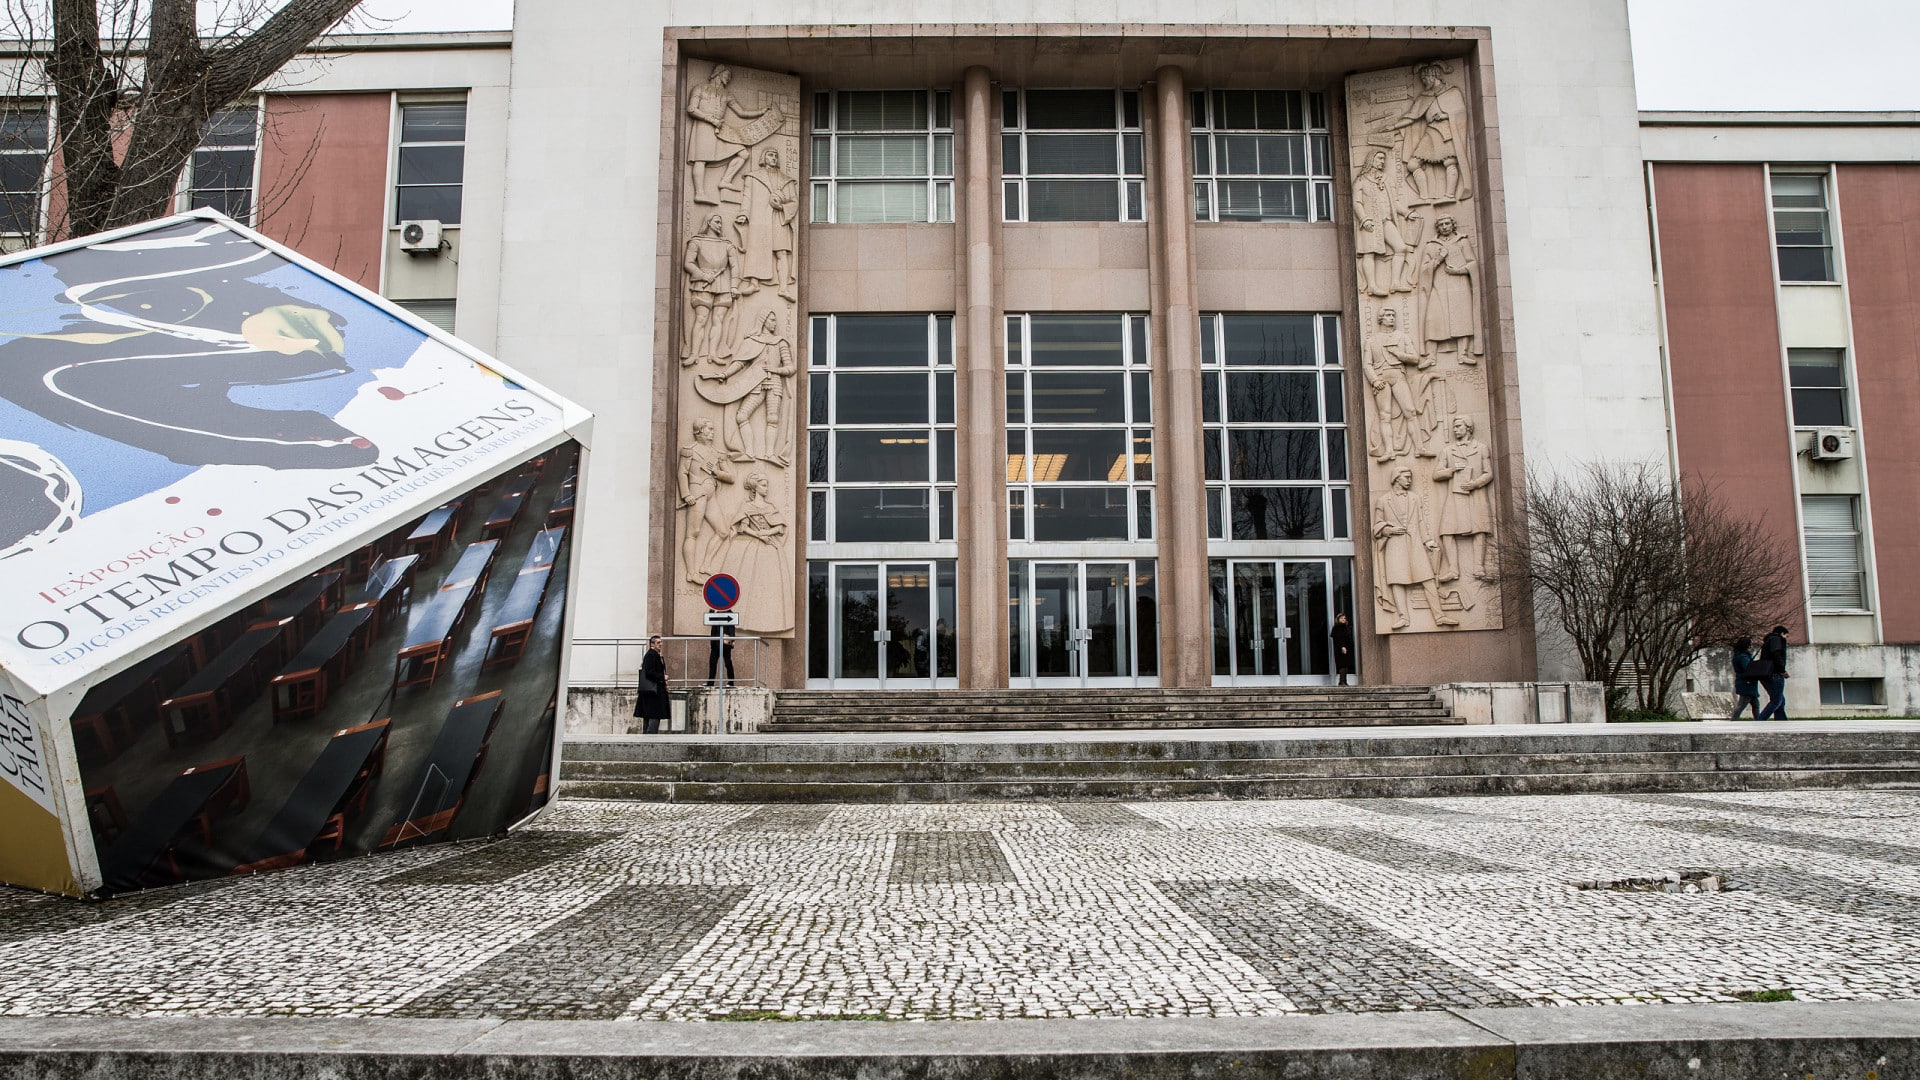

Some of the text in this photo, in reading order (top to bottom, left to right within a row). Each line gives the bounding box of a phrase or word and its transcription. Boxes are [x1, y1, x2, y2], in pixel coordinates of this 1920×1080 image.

[17, 399, 536, 650] O TEMPO DAS IMAGENS
[49, 415, 554, 665] EDIÇÕES RECENTES DO CENTRO PORTUGUÊS DE SERIGRAFIA
[52, 526, 206, 597] EXPOSIÇÃO
[3, 693, 46, 796] TARIA
